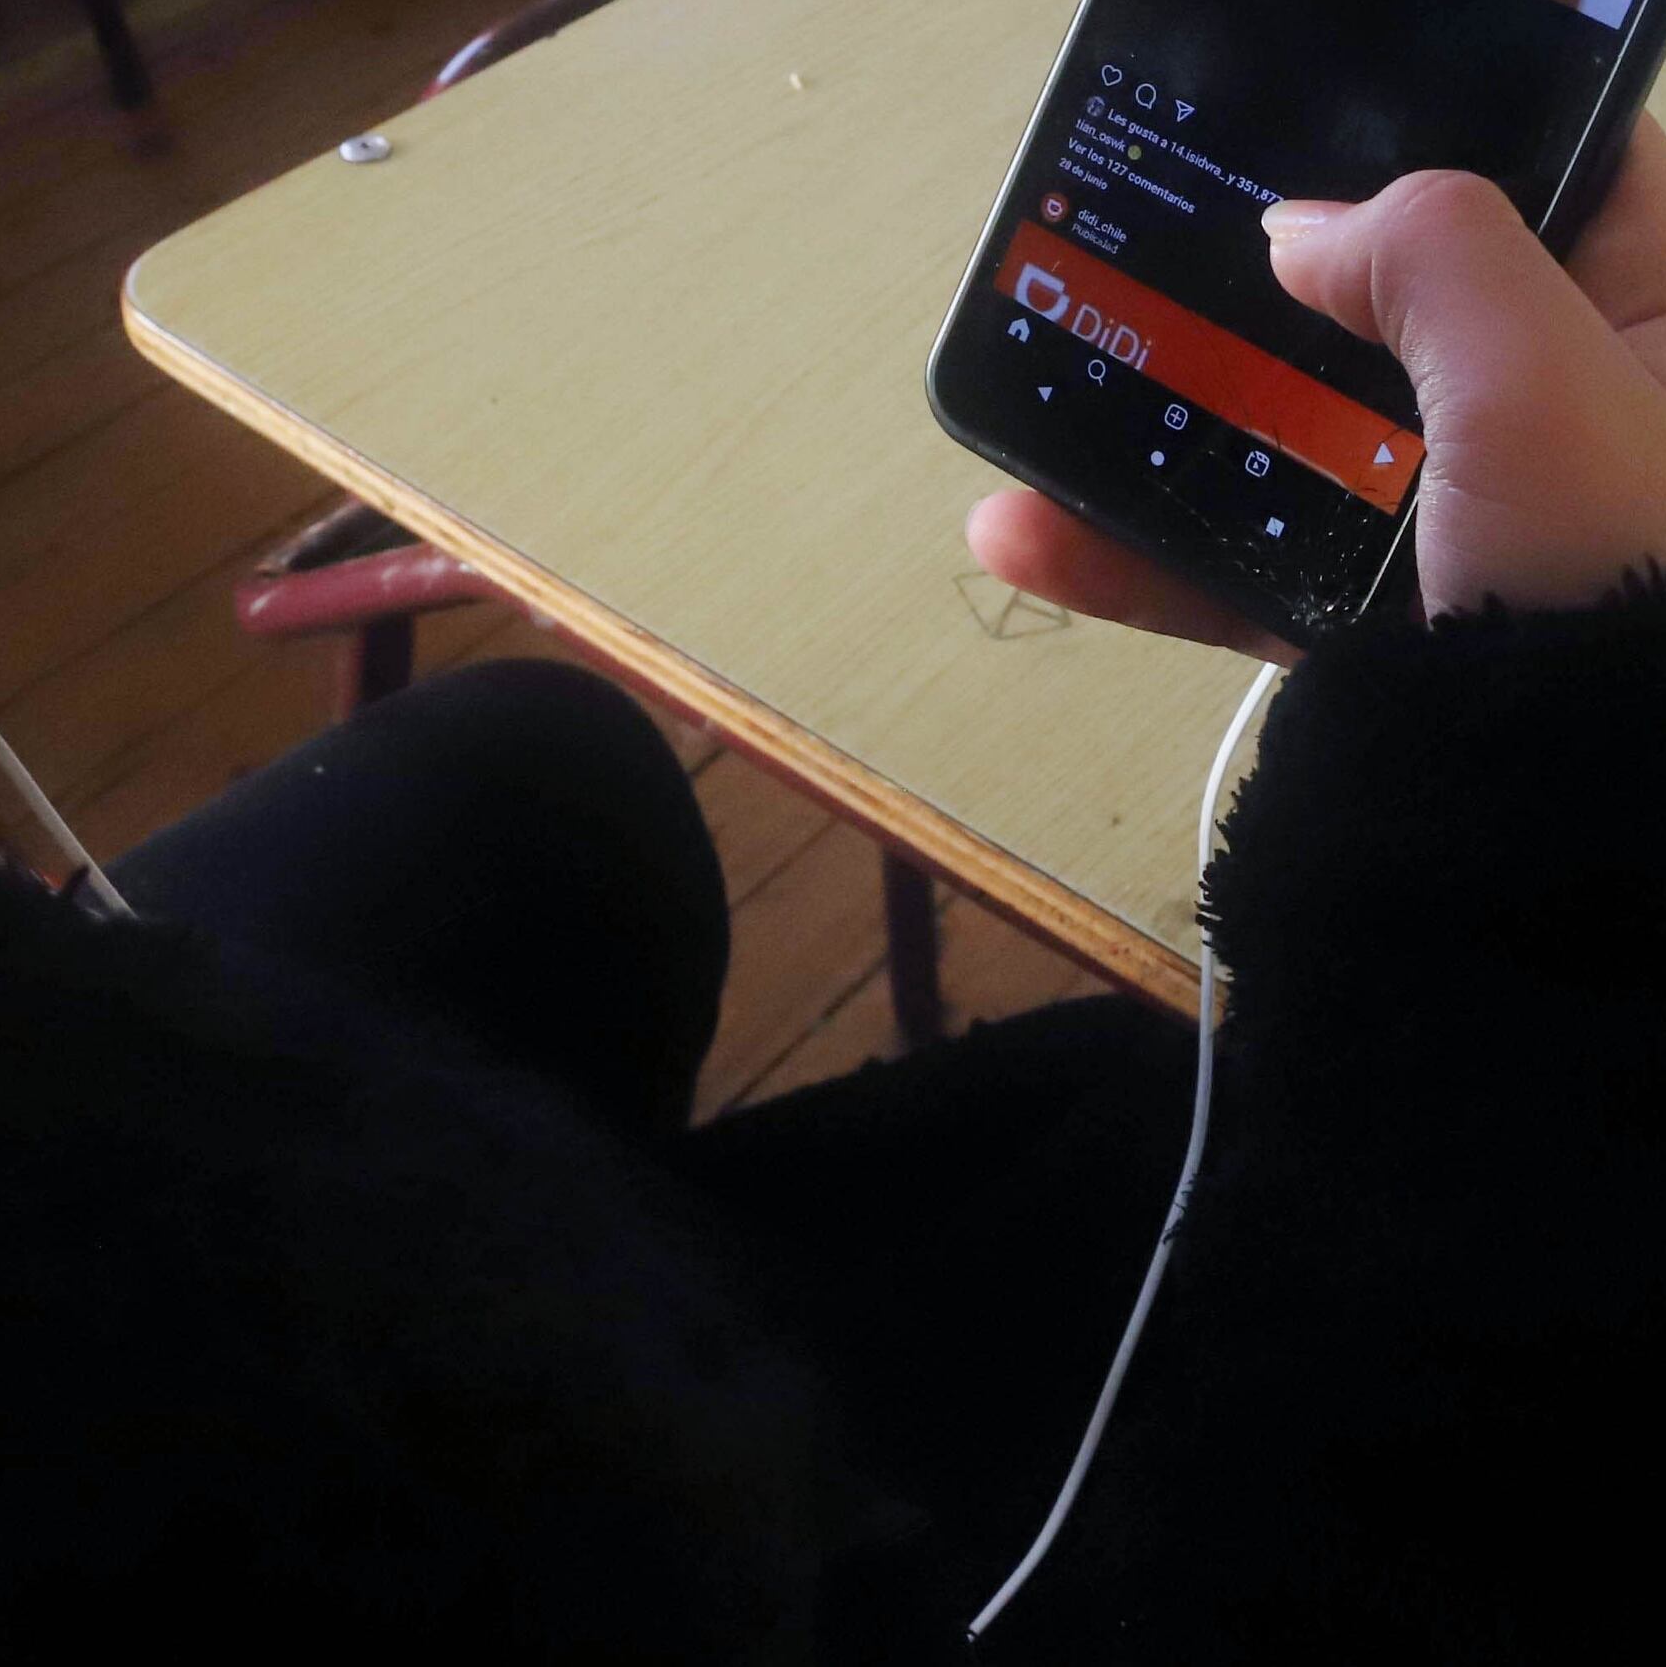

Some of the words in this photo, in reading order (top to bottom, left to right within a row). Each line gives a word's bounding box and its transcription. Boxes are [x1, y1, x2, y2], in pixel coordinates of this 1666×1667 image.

[1068, 137, 1088, 155] Ver
[1087, 147, 1105, 166] los
[1107, 158, 1129, 176] 127
[1127, 172, 1196, 214] comentarios
[1071, 165, 1084, 177] de
[1082, 170, 1109, 191] junio
[1107, 108, 1128, 127] Les
[1127, 122, 1159, 144] gusta
[1159, 138, 1168, 148] a
[1226, 173, 1237, 186] y
[1077, 209, 1127, 244] didi_chile
[1070, 303, 1153, 371] DiDi
